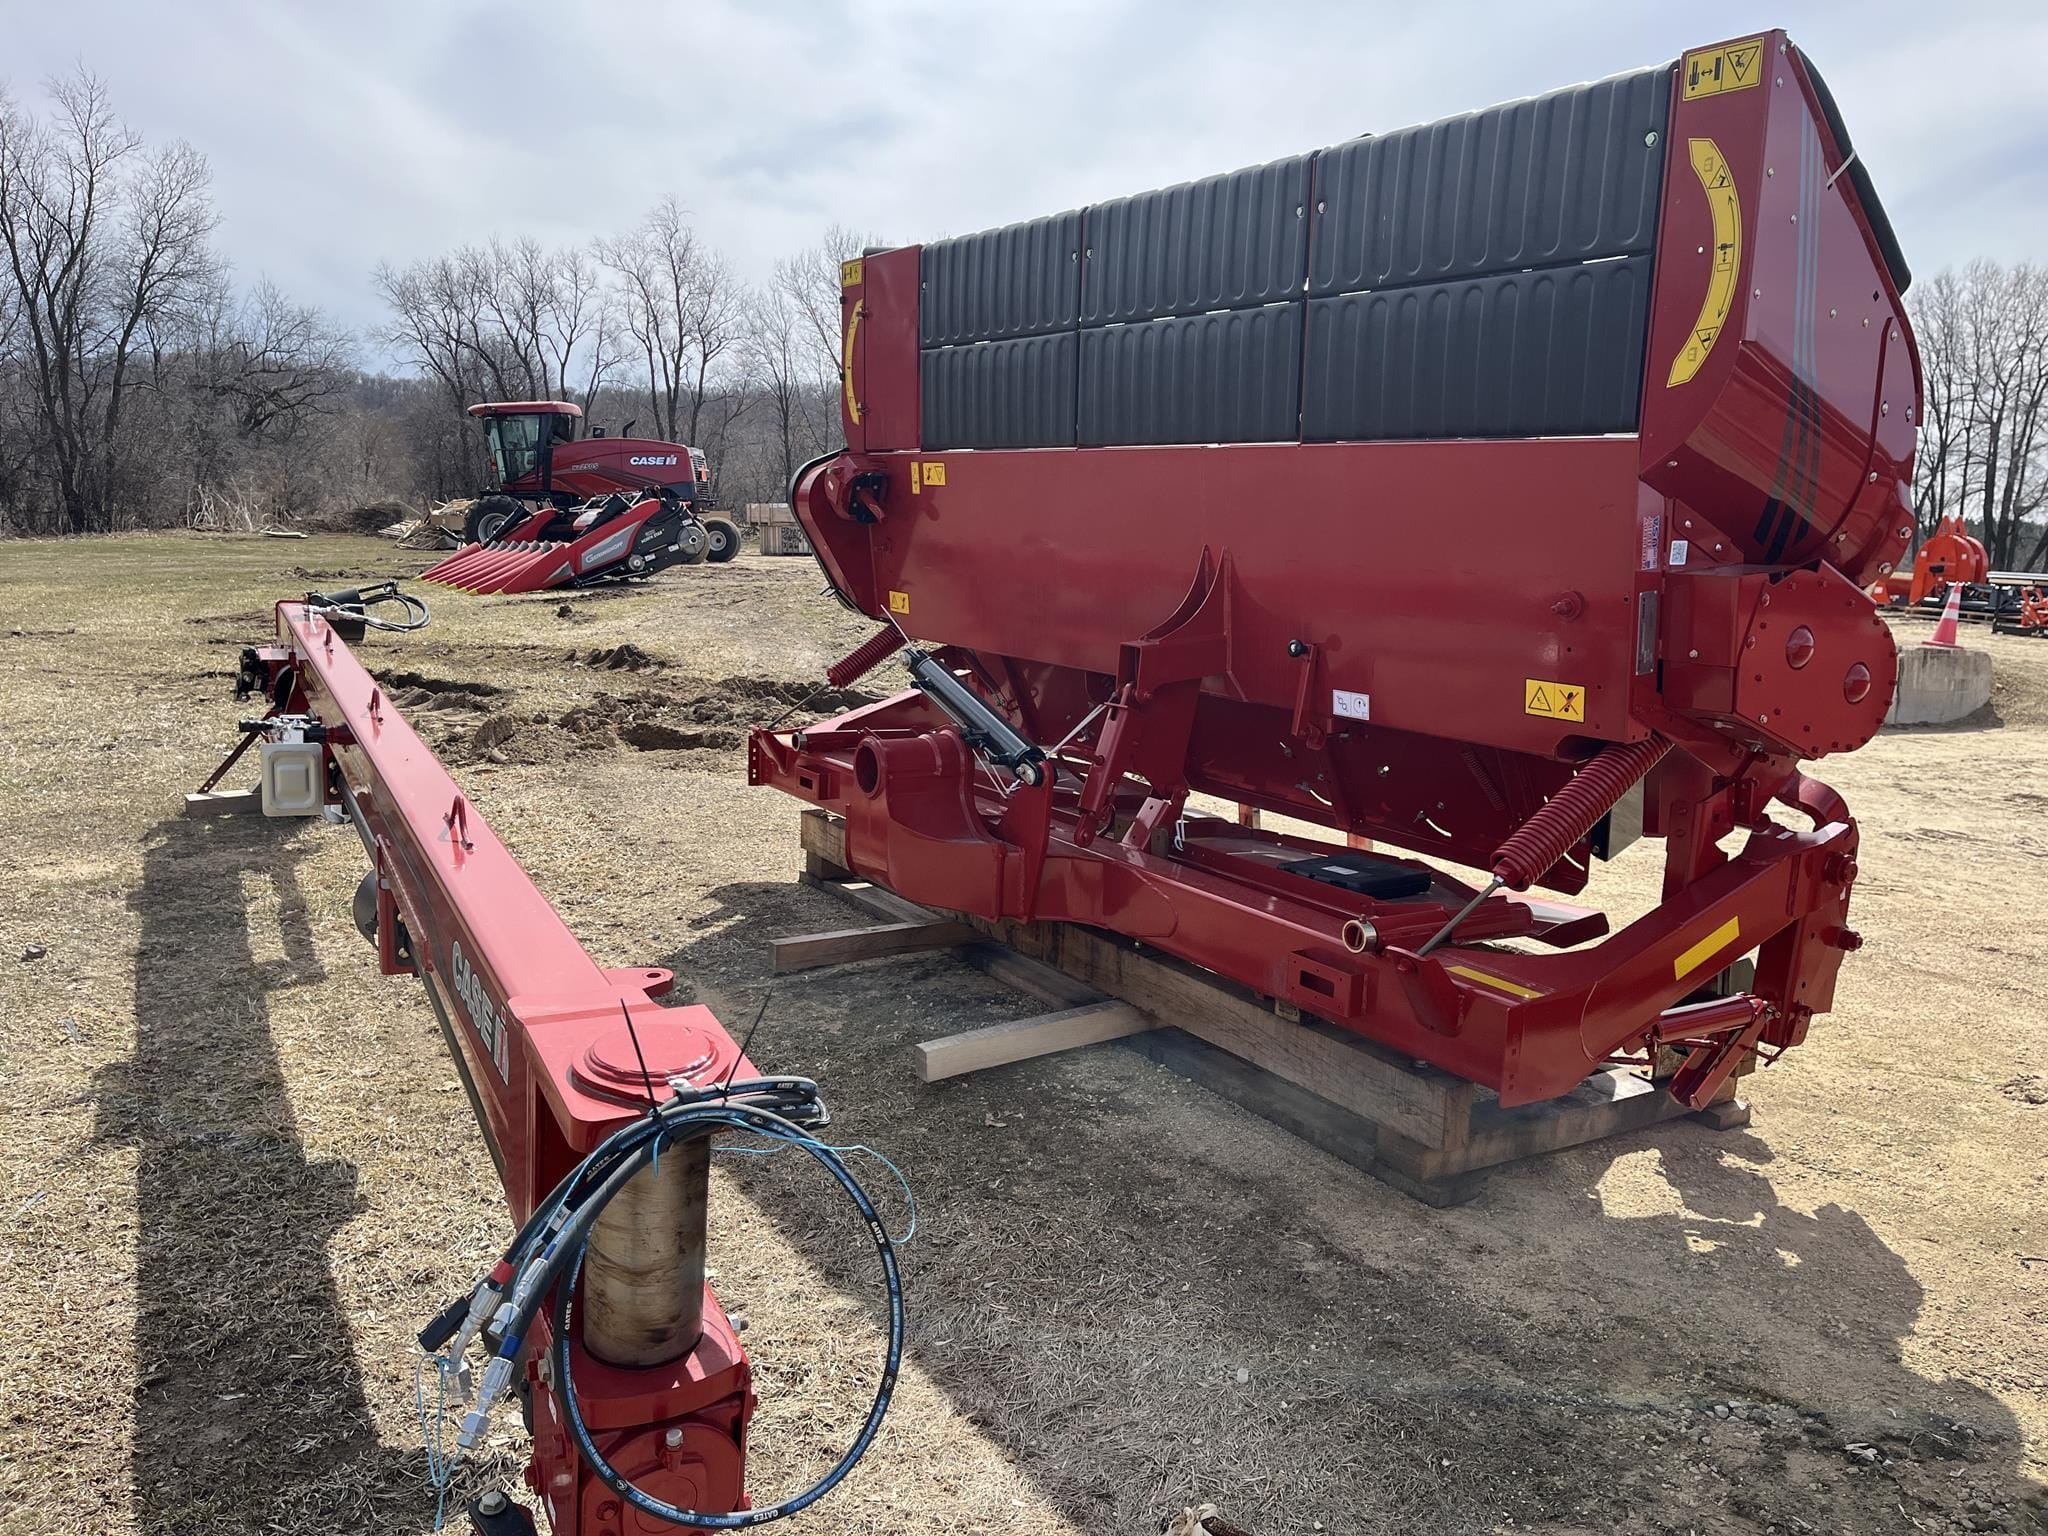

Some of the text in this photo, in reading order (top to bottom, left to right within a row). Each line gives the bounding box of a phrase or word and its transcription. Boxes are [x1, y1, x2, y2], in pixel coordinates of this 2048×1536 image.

[630, 456, 665, 465] CASE
[452, 940, 494, 1053] CASE
[870, 1221, 886, 1244] GATES
[564, 1302, 573, 1331] GATES
[753, 1509, 779, 1523] GATES
